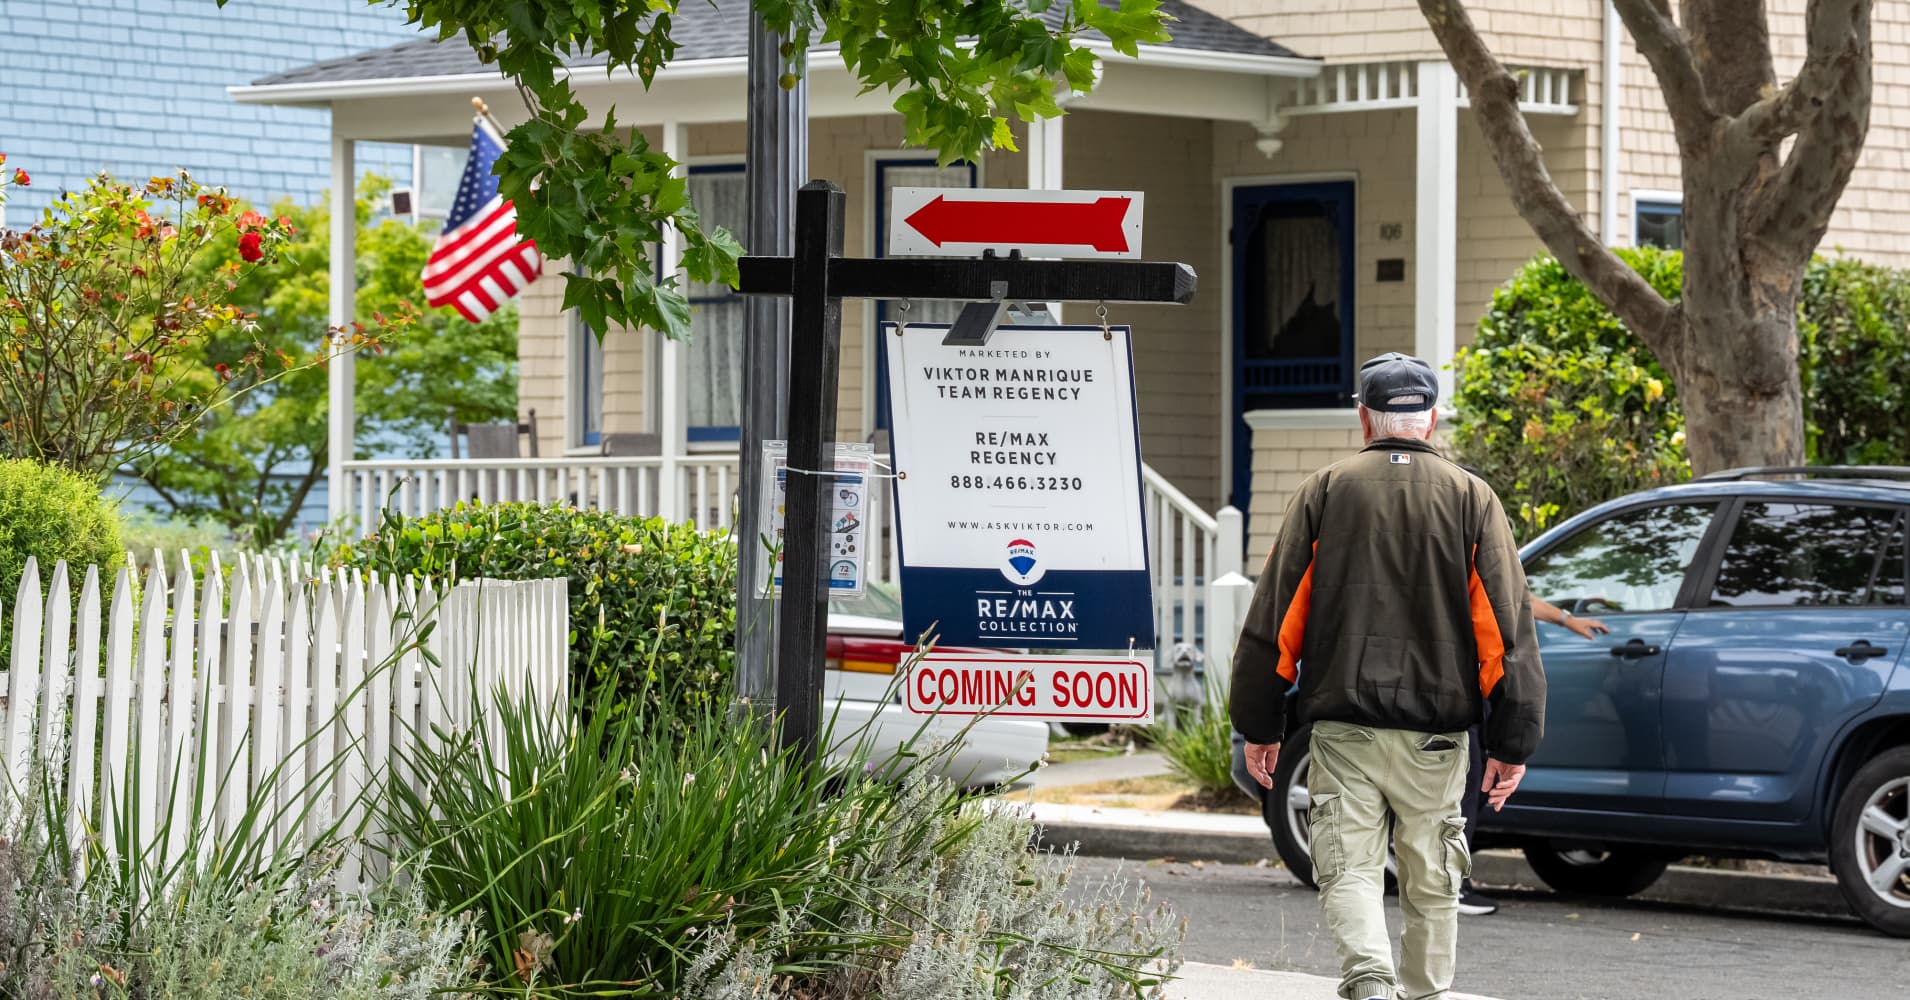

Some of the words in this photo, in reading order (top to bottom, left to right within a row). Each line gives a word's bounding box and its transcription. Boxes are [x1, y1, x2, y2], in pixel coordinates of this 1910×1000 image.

[959, 349, 1028, 359] MARKETED
[1035, 351, 1051, 359] BY
[923, 367, 990, 382] VIKTOR
[996, 368, 1093, 383] MANRIQUE
[937, 385, 987, 399] TEAM
[993, 386, 1081, 401] REGENCY
[975, 431, 1049, 446] RE/MAX
[970, 451, 1057, 465] REGENCY
[950, 475, 1083, 491] 888.466.3230
[947, 520, 1094, 532] WWW.ASKVIKTOR.COM
[1009, 547, 1034, 556] RE/MAX
[1017, 589, 1033, 597] THE
[977, 599, 1075, 619] RE/MAX
[979, 621, 1077, 633] COLLECTION
[917, 668, 1036, 707] COMING
[1052, 670, 1138, 709] SOON
